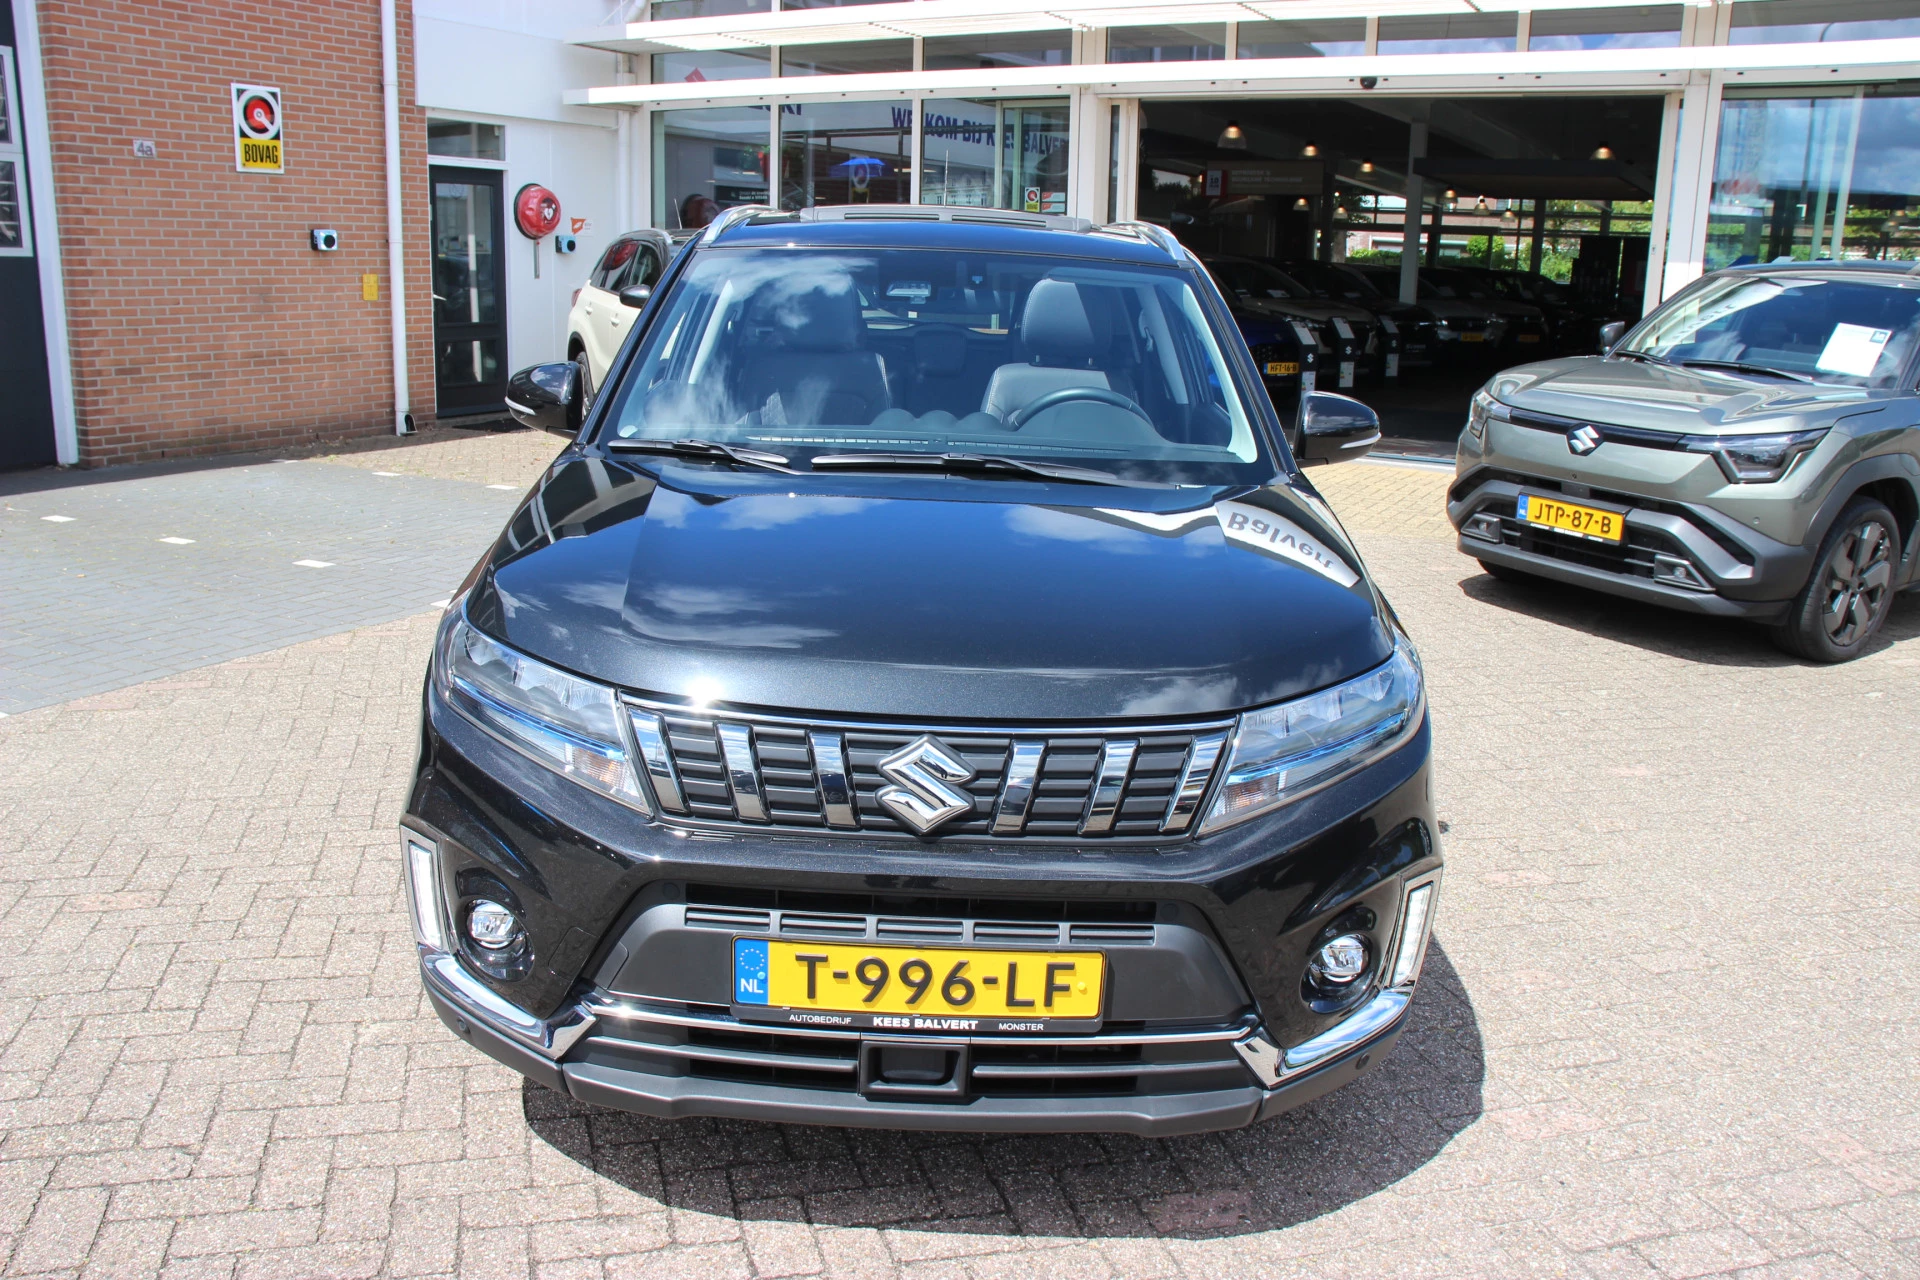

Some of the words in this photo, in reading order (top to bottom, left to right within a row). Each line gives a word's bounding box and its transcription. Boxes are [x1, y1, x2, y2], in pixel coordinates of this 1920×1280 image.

[891, 106, 958, 140] WEKOM
[986, 125, 1014, 149] KE
[136, 141, 154, 157] 4a
[244, 143, 279, 164] BOVAG
[1534, 502, 1612, 535] JTP-87-B
[740, 978, 764, 994] NL
[795, 952, 1075, 1008] T-996-LF
[789, 1014, 852, 1025] AUTOBEDRIJF
[872, 1016, 911, 1028] KEES
[914, 1018, 978, 1030] BALVERT
[998, 1022, 1044, 1031] MONSTER
